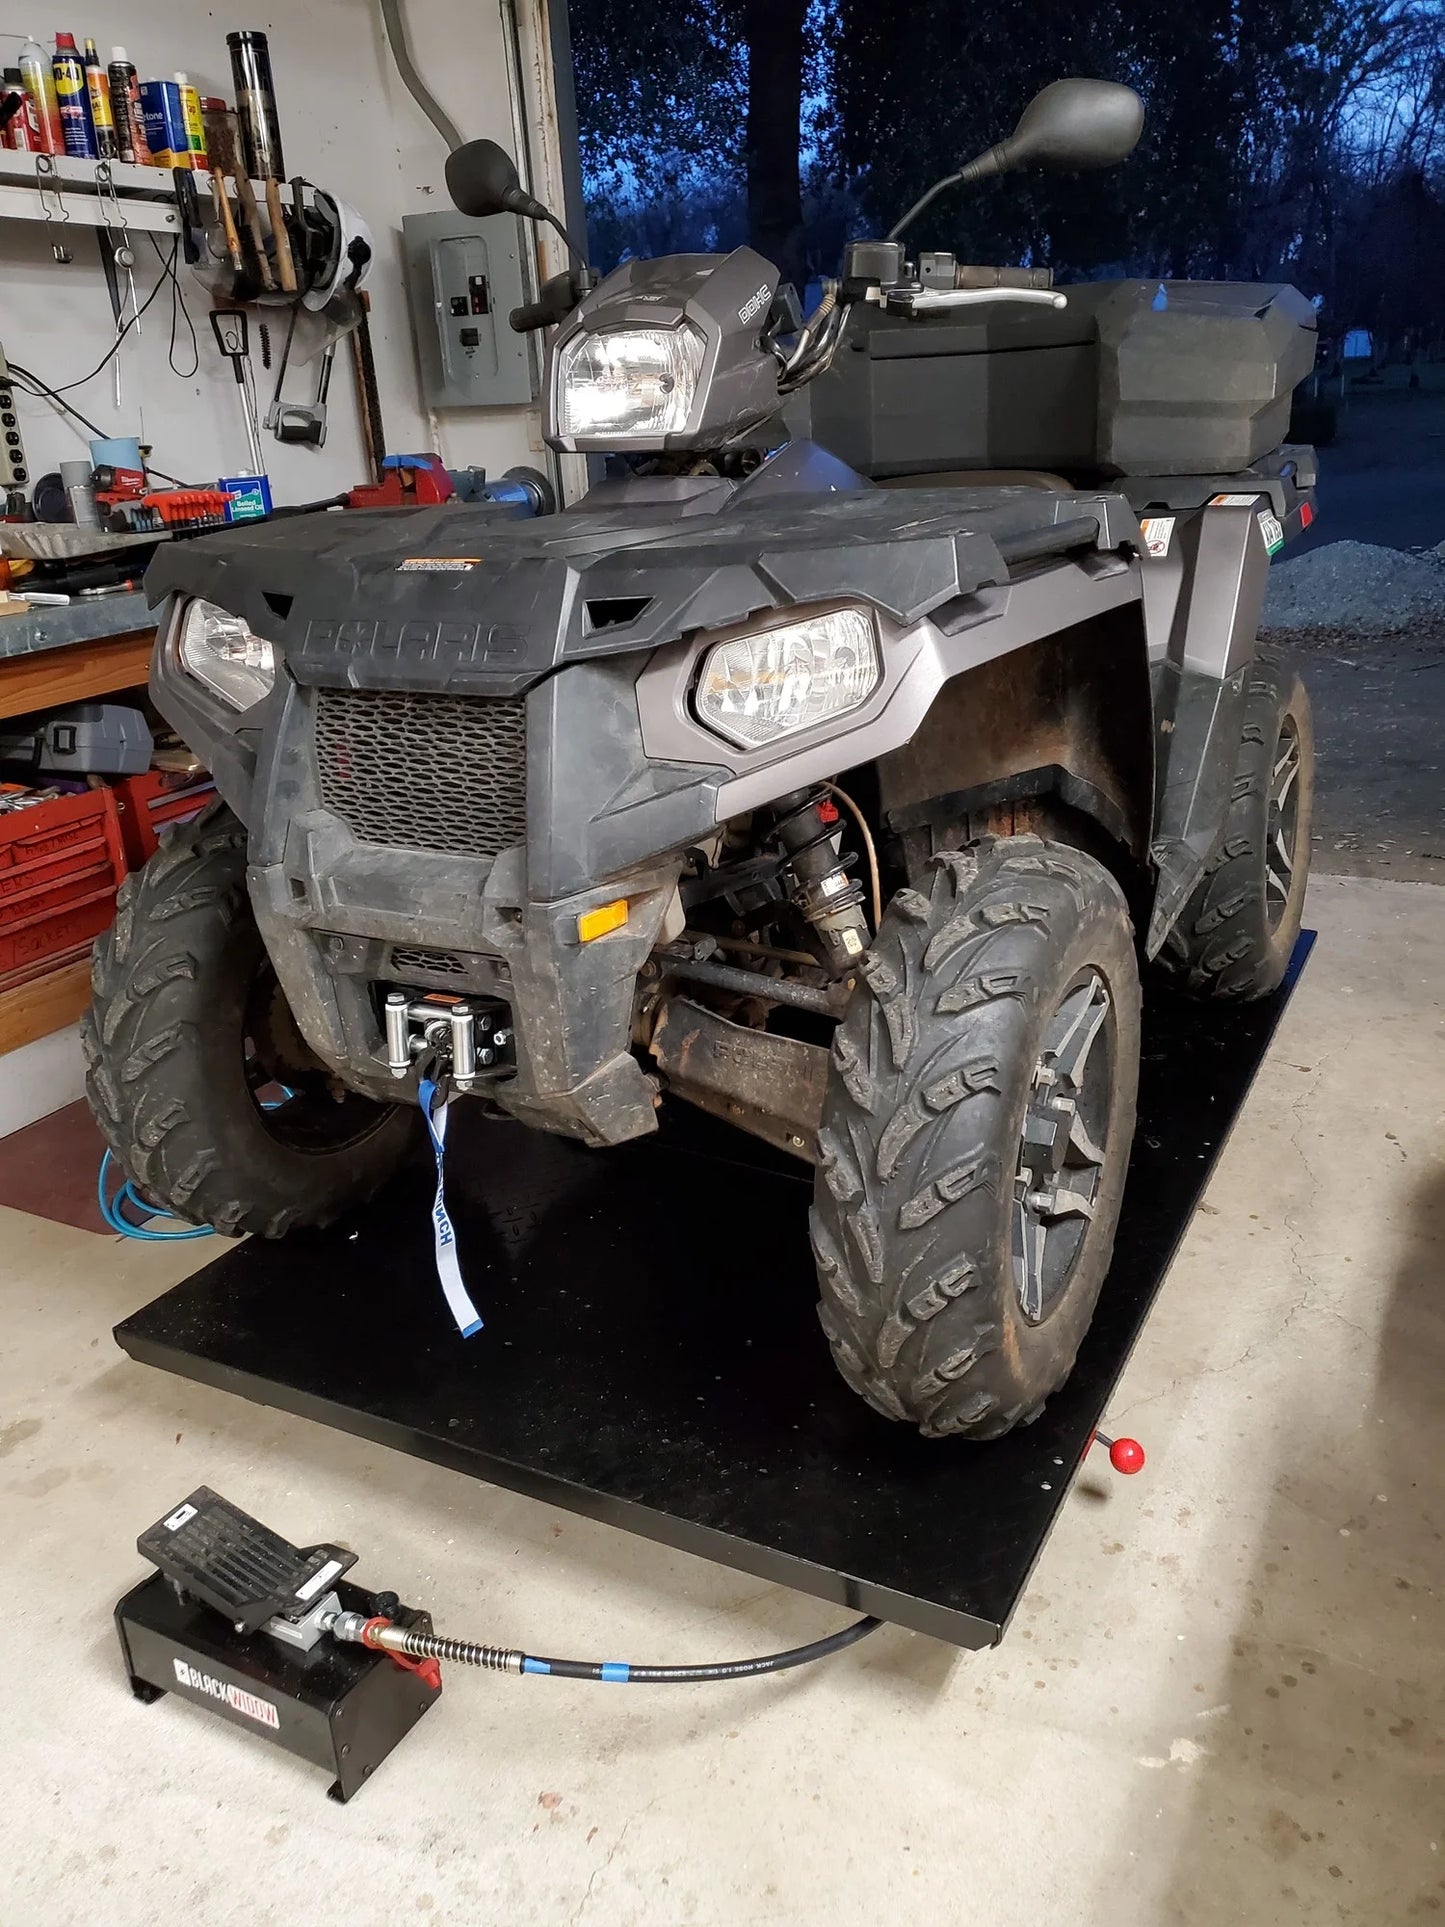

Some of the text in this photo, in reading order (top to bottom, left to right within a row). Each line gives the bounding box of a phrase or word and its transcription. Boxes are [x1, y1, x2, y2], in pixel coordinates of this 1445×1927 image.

[302, 618, 529, 662] POLARIS
[734, 1665, 754, 1673] HOSE
[756, 1660, 775, 1669] JACK
